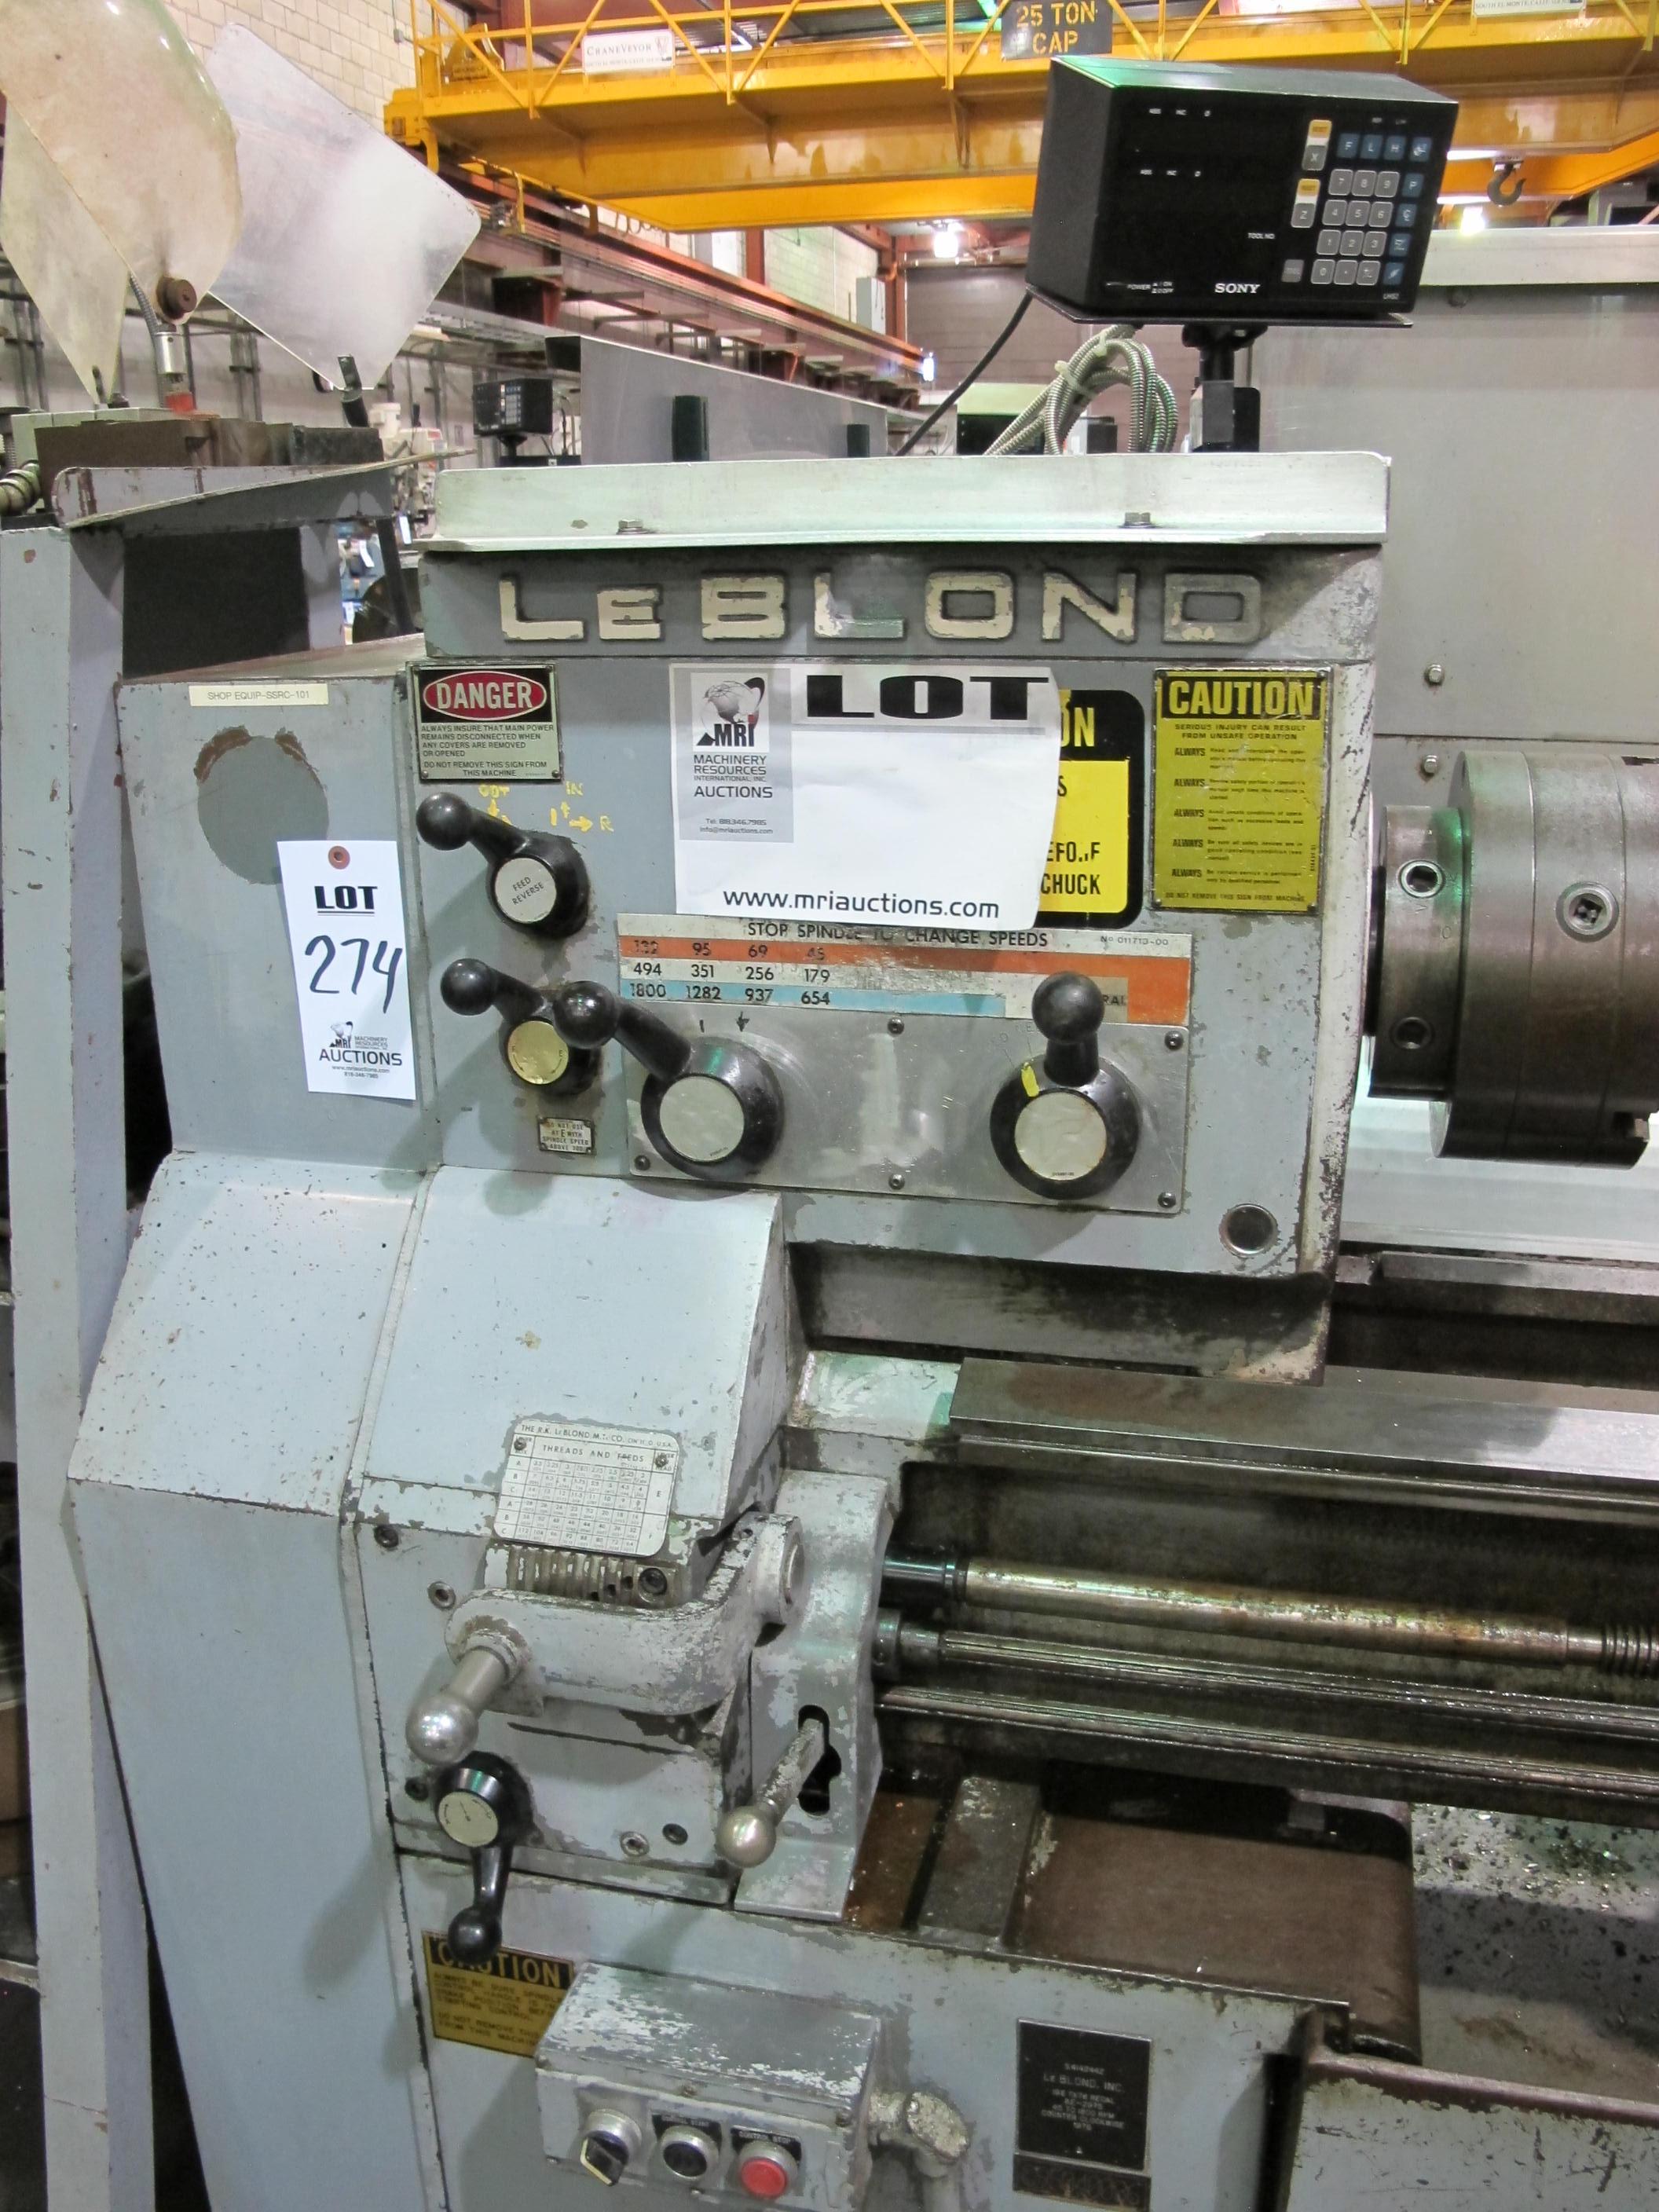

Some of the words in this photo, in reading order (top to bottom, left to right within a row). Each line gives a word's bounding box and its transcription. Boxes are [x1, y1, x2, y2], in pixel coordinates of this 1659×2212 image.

[1016, 4, 1043, 28] 25
[1051, 1, 1096, 25] TON
[1032, 30, 1079, 54] CAP
[1345, 141, 1353, 150] F
[1368, 142, 1374, 152] L
[1391, 144, 1400, 152] H
[1310, 152, 1319, 163] X
[1361, 179, 1368, 189] 8
[1383, 180, 1390, 189] 9
[1300, 211, 1308, 220] Z
[1354, 209, 1362, 218] 5
[1377, 211, 1384, 219] 6
[1349, 239, 1356, 248] 2
[1372, 240, 1378, 248] 3
[1214, 283, 1261, 294] SONY
[207, 691, 233, 701] SHOP
[234, 690, 309, 700] EQUIP-SSRC-101
[436, 681, 533, 709] DANGER
[807, 674, 1049, 720] LOT
[1169, 680, 1313, 716] CAUTION
[1174, 748, 1206, 756] ALWAYS
[694, 754, 767, 765] MACHINERY
[694, 765, 767, 775] RESOURCES
[694, 786, 773, 798] AUCTIONS
[1174, 809, 1204, 818] ALWAYS
[1173, 839, 1203, 848] ALWAYS
[1171, 869, 1202, 877] ALWAYS
[512, 877, 532, 892] FEED
[1041, 873, 1101, 895] CHUCK
[314, 885, 378, 910] LOT
[511, 881, 544, 905] REVERSE
[723, 890, 999, 919] www.mriauctions.com
[748, 923, 787, 937] STOP
[906, 929, 979, 944] CHANGE
[988, 931, 1048, 947] SPEEDS
[693, 943, 711, 957] 95
[749, 945, 767, 958] 69
[305, 935, 403, 1014] 274
[633, 963, 662, 976] 494
[690, 965, 715, 978] 351
[745, 967, 774, 980] 256
[804, 969, 830, 983] 179
[632, 983, 666, 998] 1800
[687, 985, 721, 1000] 1282
[745, 988, 774, 1002] 937
[801, 991, 830, 1005] 654
[319, 1049, 403, 1066] AUCTIONS
[561, 1129, 566, 1138] E
[543, 1445, 584, 1456] THREADS
